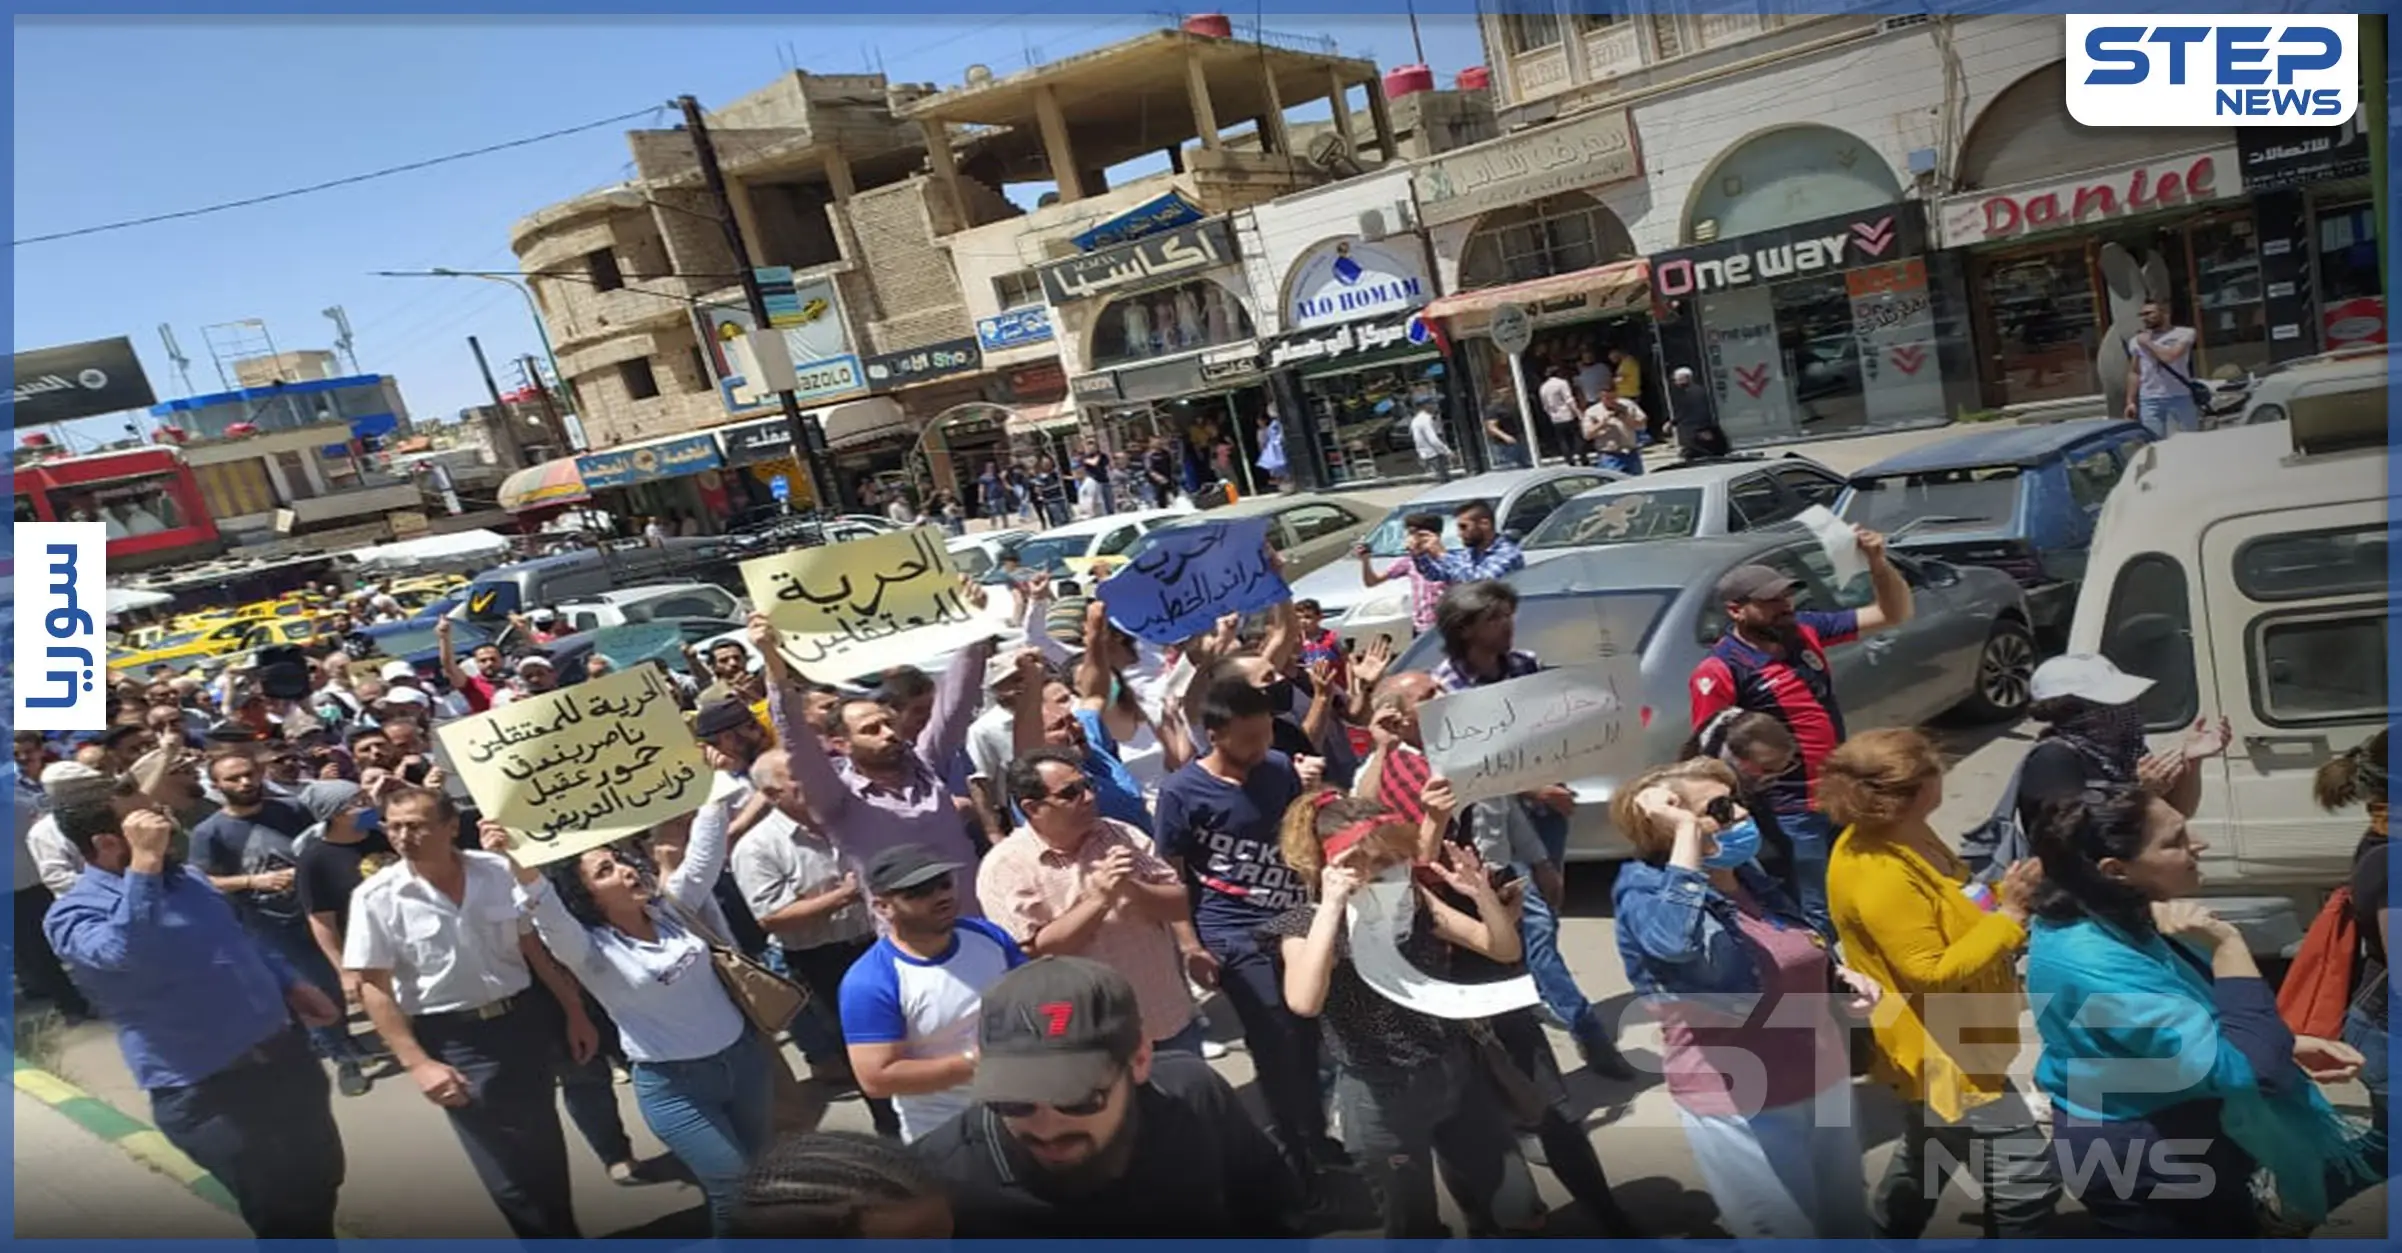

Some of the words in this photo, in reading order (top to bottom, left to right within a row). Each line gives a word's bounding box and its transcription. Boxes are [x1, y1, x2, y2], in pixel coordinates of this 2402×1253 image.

[1982, 156, 2215, 236] Daniel
[1295, 299, 1335, 320] ALO
[1338, 277, 1421, 311] HOMAM
[1659, 253, 1749, 297] One
[771, 530, 944, 616] الحرية
[781, 587, 973, 663] للمعتقلين
[468, 694, 583, 763] للمعتقلين
[589, 669, 665, 720] الحرية
